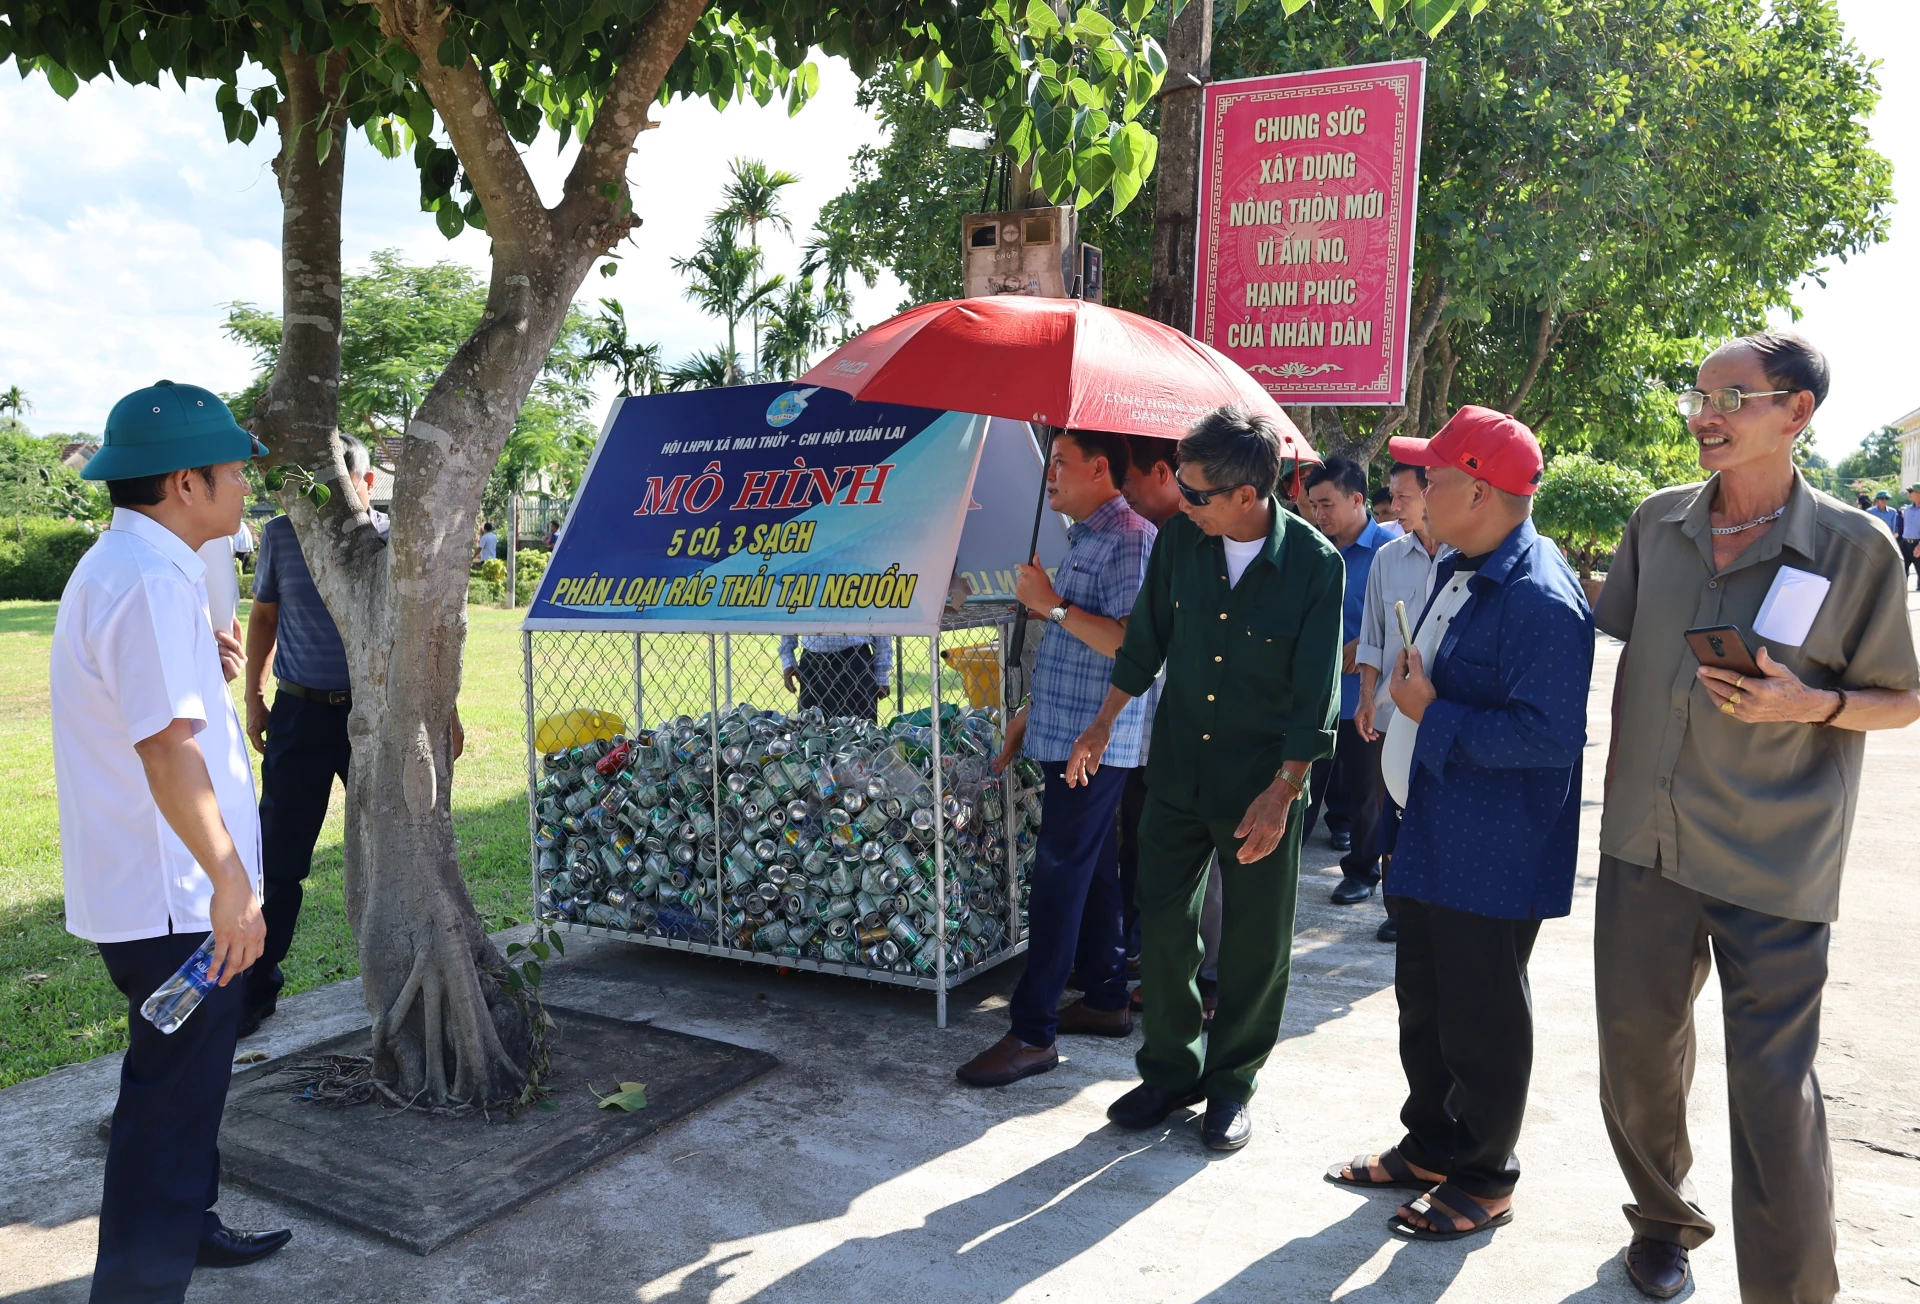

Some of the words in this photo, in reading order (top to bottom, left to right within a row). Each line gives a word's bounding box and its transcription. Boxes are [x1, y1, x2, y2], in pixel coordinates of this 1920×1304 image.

[1255, 113, 1320, 143] CHUNG
[1326, 106, 1366, 137] SỨC
[1260, 153, 1298, 184] XÂY
[1302, 152, 1357, 186] DỰNG
[1230, 196, 1282, 227] NÔNG
[1289, 193, 1340, 222] THÔN
[1345, 189, 1384, 219] MỚI
[1257, 236, 1275, 266] VÌ
[1279, 231, 1310, 265] ẤM
[1317, 237, 1349, 266] NO,
[1246, 283, 1298, 313] HẠNH
[1303, 276, 1356, 306] PHÚC
[1228, 316, 1264, 348] CỦA
[1270, 319, 1326, 347] NHÂN
[1330, 316, 1372, 346] DÂN
[661, 441, 681, 455] HỘI
[682, 440, 713, 453] LHPN
[713, 438, 731, 452] XÃ
[732, 437, 758, 450] MAI
[759, 431, 788, 449] THỦY
[799, 433, 820, 446] CHI
[821, 431, 844, 447] HỘI
[846, 426, 882, 443] XUÂN
[884, 426, 906, 440] LAI
[634, 461, 725, 516] MÔ
[729, 457, 896, 511] HÌNH
[667, 529, 685, 557] 5
[686, 524, 721, 559] CÓ,
[728, 526, 749, 552] 3
[749, 521, 816, 561] SẠCH
[550, 572, 611, 606] PHÂN
[614, 576, 668, 613] LOẠI
[669, 573, 715, 608] RÁC
[718, 565, 776, 608] THẢI
[779, 573, 817, 614] TẠI
[821, 562, 918, 609] NGUỒN
